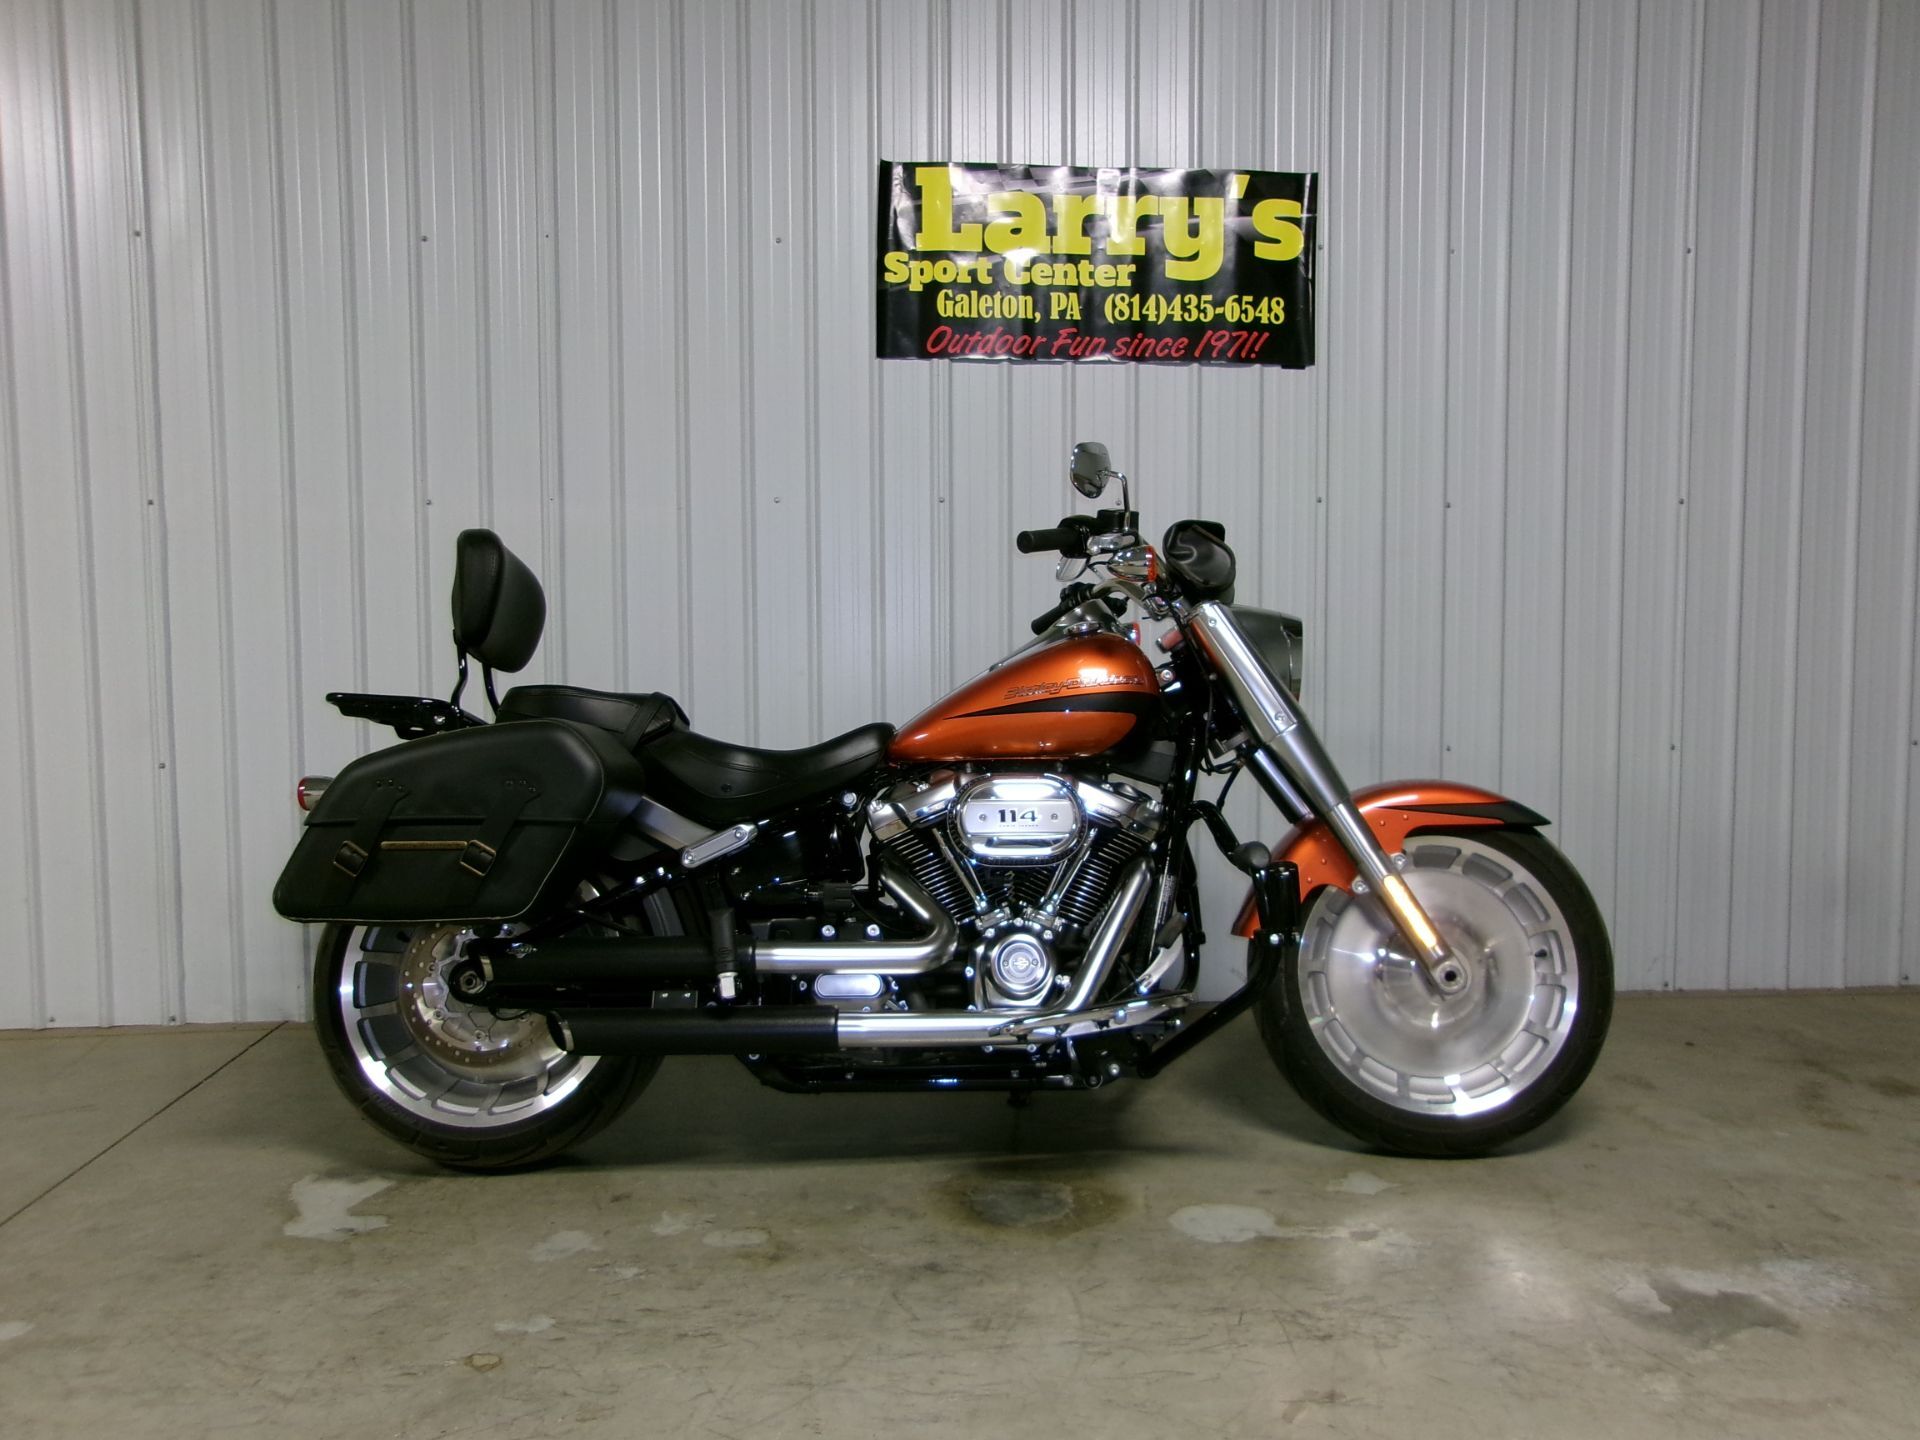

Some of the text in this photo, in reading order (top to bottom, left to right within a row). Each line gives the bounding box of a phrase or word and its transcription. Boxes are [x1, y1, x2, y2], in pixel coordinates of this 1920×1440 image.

[914, 166, 1305, 282] Larry's
[884, 252, 1136, 291] Sport Center
[936, 289, 1285, 325] Galeton, PA (814)435-6548
[926, 325, 1270, 359] Outdoor Fun since 1971!
[998, 809, 1037, 823] 114
